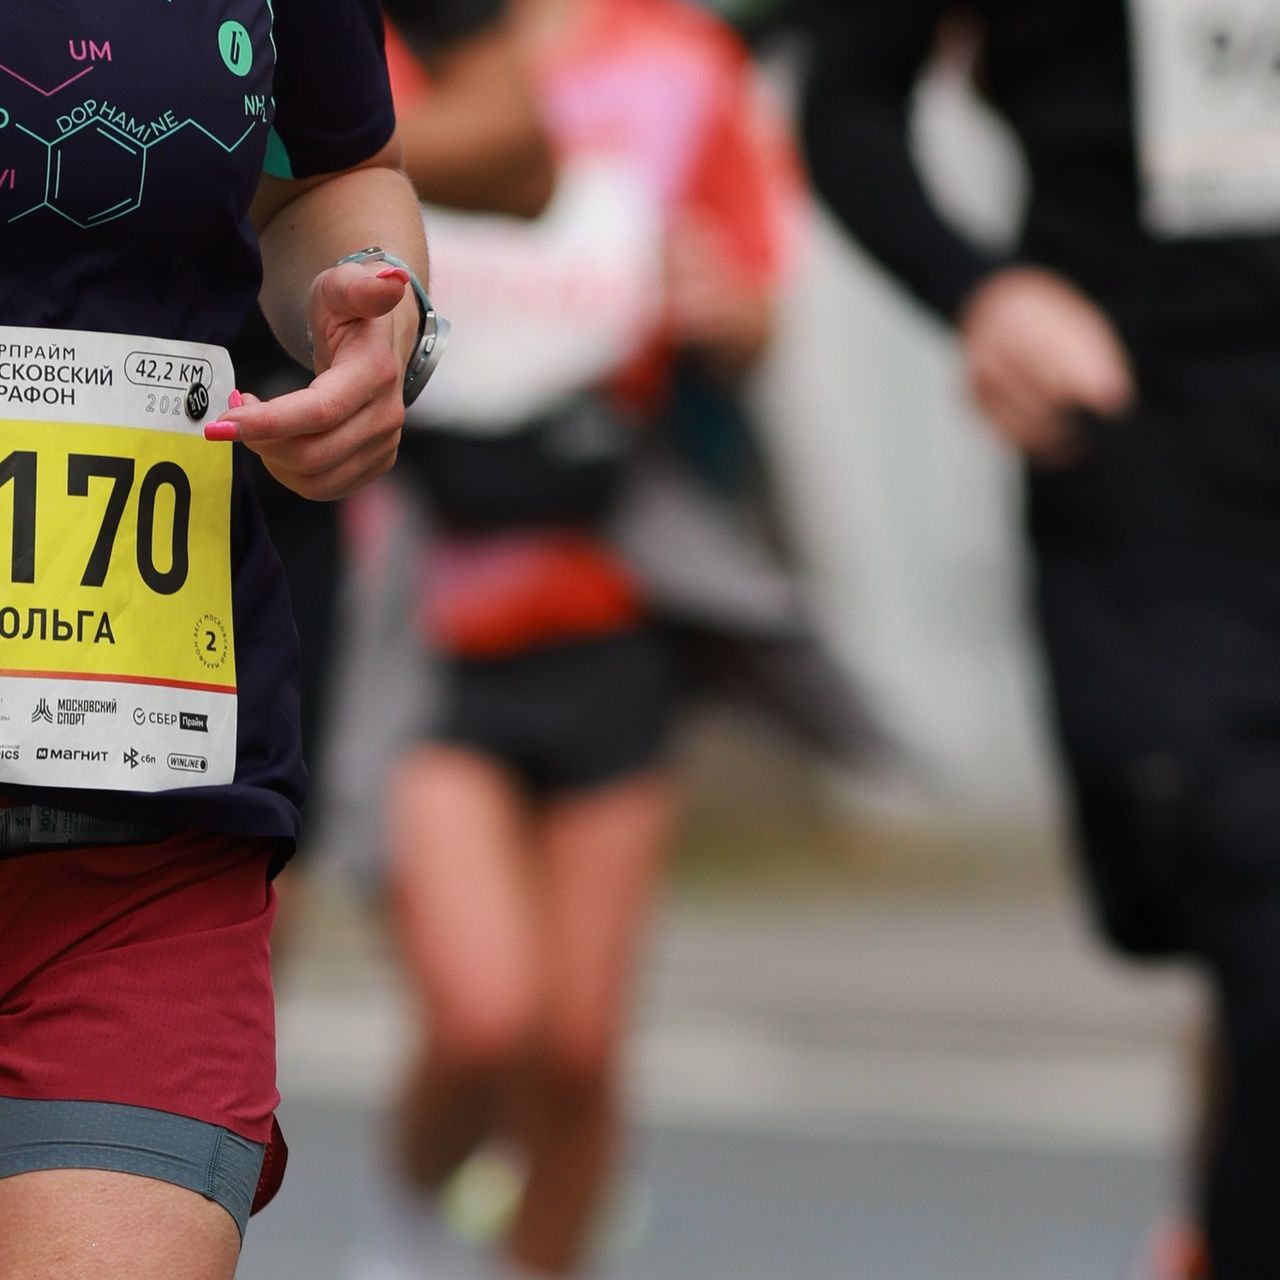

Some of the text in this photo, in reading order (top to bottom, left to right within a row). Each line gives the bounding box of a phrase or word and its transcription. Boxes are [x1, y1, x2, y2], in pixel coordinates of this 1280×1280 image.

[69, 40, 112, 61] UM
[56, 99, 179, 141] DOPHAMINE
[136, 359, 173, 382] 42,2
[145, 393, 182, 416] 202
[193, 387, 208, 411] 10
[206, 630, 217, 652] 2
[58, 698, 117, 714] МОСКОВСКИЙ
[57, 712, 86, 725] СПОРТ
[148, 712, 204, 728] СБЕР Прайм
[50, 749, 109, 761] магнит
[141, 754, 156, 764] сбп
[170, 756, 199, 769] WINLINE
